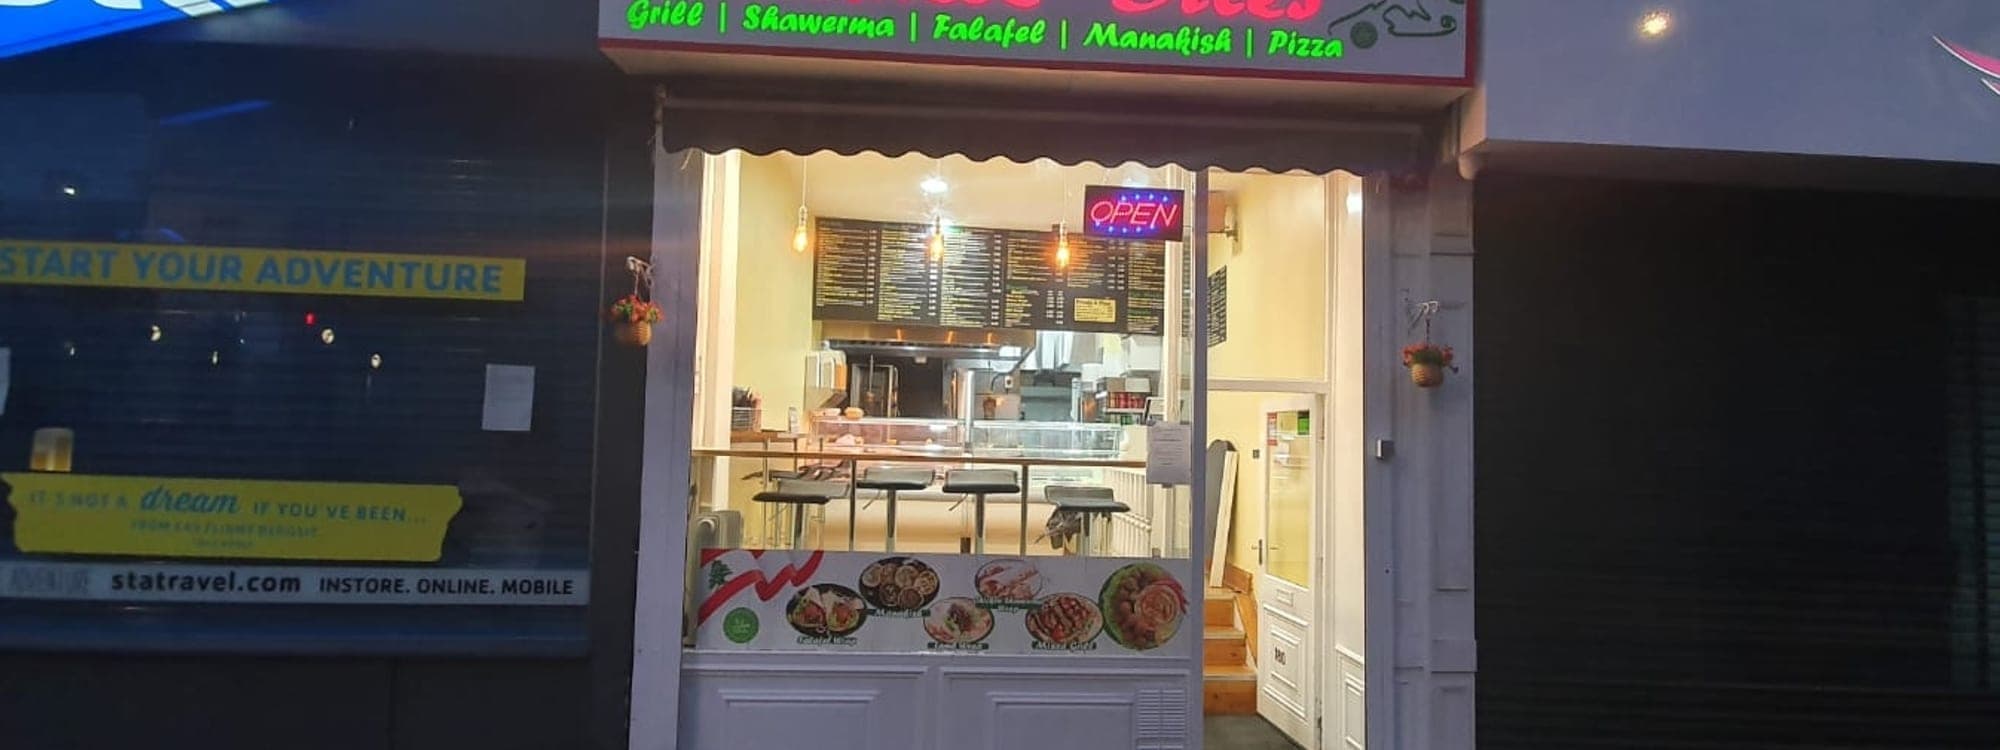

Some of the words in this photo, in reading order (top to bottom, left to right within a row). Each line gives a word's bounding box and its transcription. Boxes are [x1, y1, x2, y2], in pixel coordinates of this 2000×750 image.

[627, 0, 704, 30] Grill
[742, 3, 896, 39] Shawerma
[933, 13, 1047, 48] Falafel
[1083, 22, 1232, 57] Manakish
[1267, 29, 1344, 58] Pizza
[1091, 200, 1178, 228] OPEN
[0, 246, 118, 279] START
[133, 252, 244, 283] YOUR
[256, 255, 503, 294] ADVENTURE
[140, 484, 240, 514] dream
[254, 502, 273, 516] IF
[111, 570, 301, 592] statravel.com
[319, 577, 411, 594] INSTORE.
[417, 578, 496, 595] ONLINE.
[502, 579, 574, 596] MOBILE
